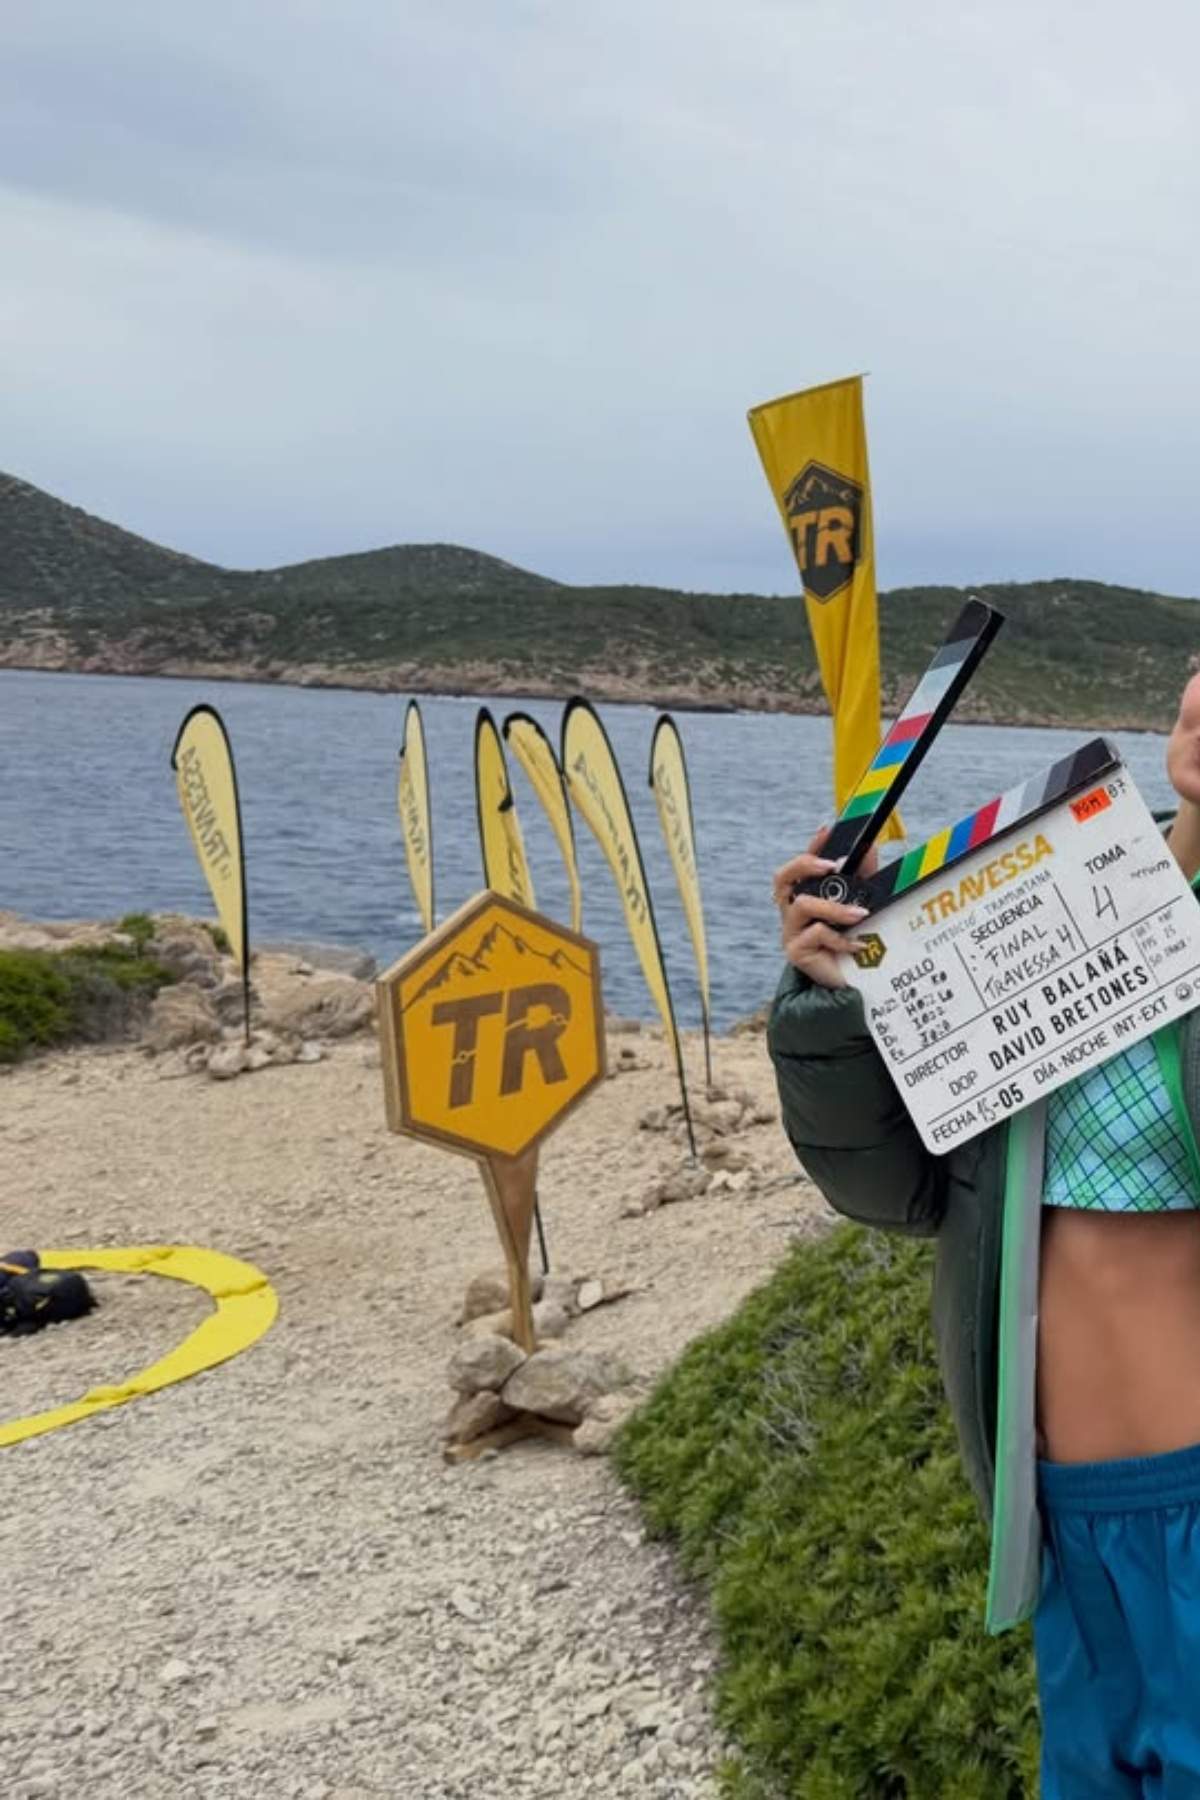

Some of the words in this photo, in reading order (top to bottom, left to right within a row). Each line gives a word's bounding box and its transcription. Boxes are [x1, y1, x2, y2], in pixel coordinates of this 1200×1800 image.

[790, 506, 854, 571] TR
[922, 834, 1054, 924] TRAVESSA
[1084, 844, 1126, 875] TOMA
[970, 894, 1043, 944] SECUENCIA
[1092, 885, 1119, 920] 4
[984, 924, 1047, 967] FINAL
[984, 944, 1061, 999] TRAVESSA
[1055, 924, 1077, 952] 4
[891, 958, 934, 992] ROLLO
[904, 1041, 969, 1088] DIRECTOR
[992, 999, 1032, 1035] RUY
[1042, 938, 1129, 1006] BALAÑÁ
[949, 1070, 979, 1096] DOP
[989, 1026, 1046, 1071] DAVID
[1050, 965, 1148, 1035] BRETONES
[431, 983, 572, 1110] TR
[931, 1110, 977, 1143] FECHA
